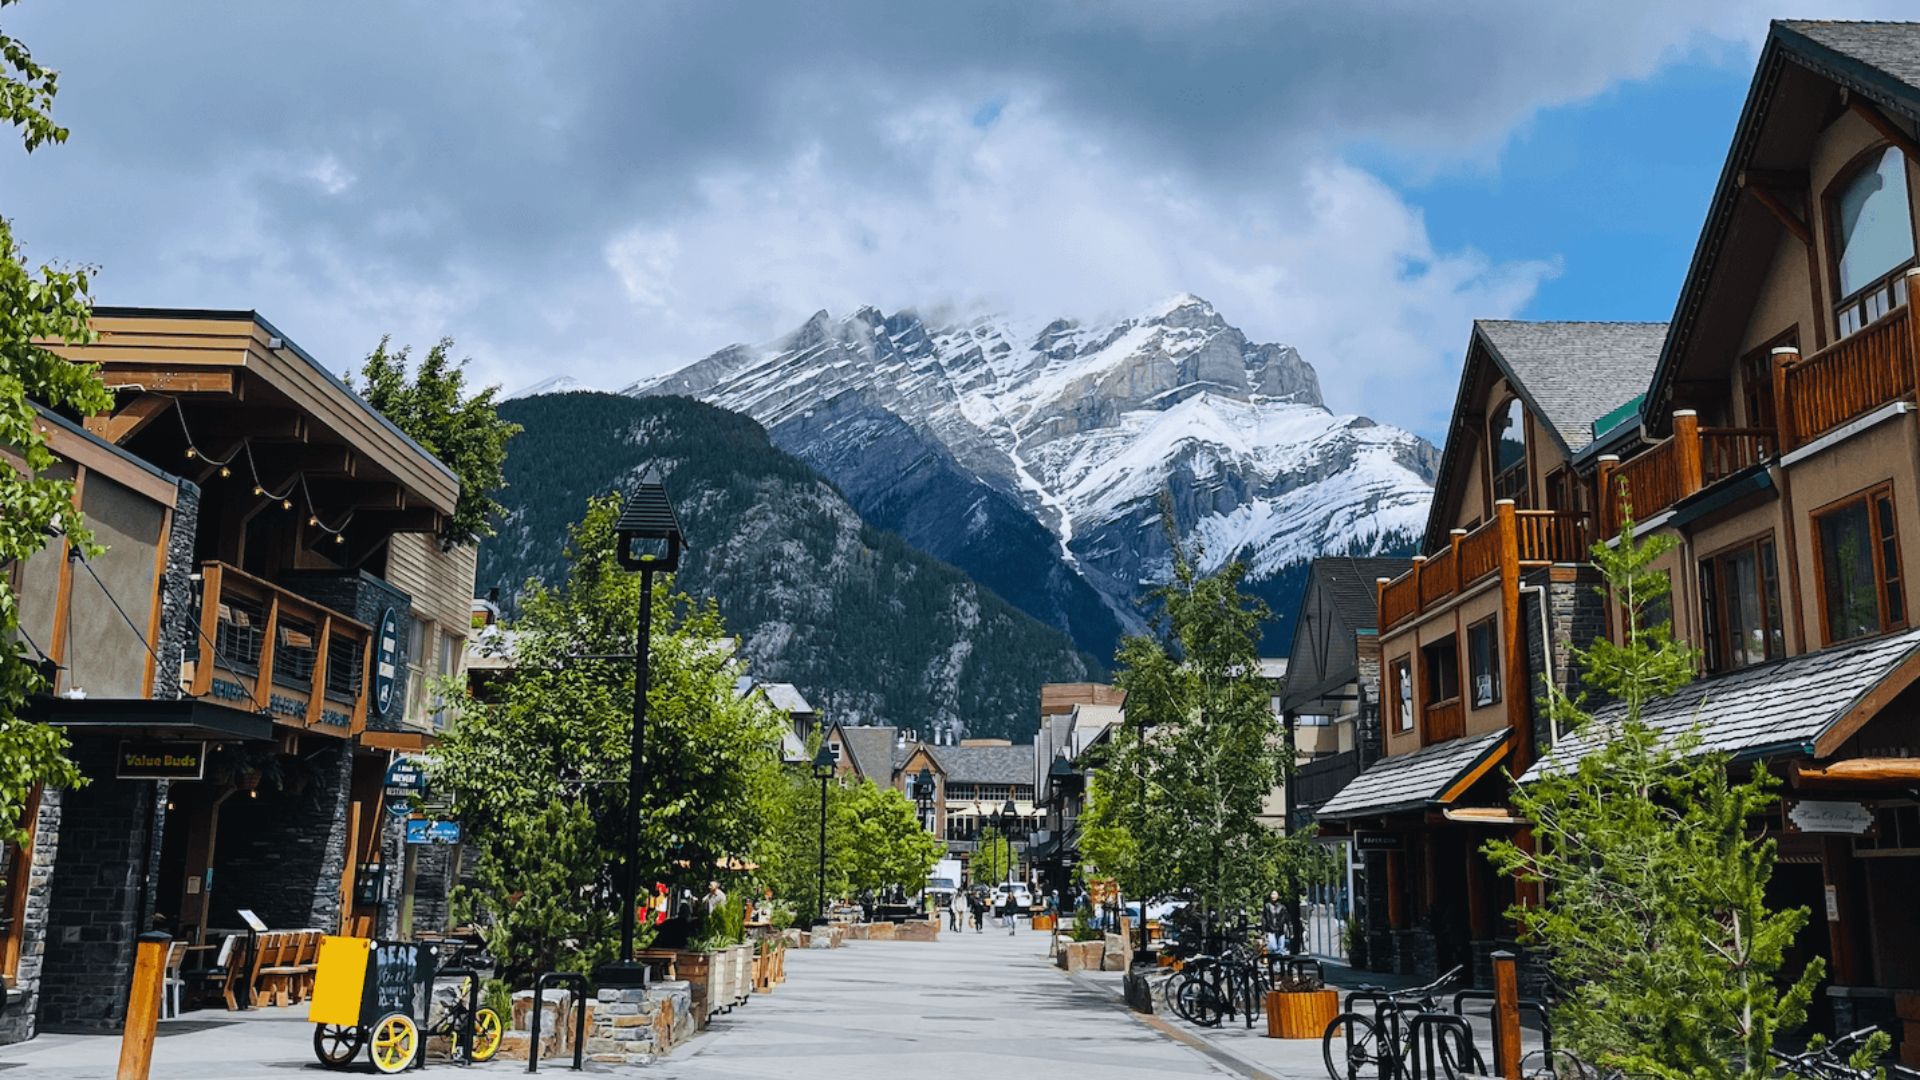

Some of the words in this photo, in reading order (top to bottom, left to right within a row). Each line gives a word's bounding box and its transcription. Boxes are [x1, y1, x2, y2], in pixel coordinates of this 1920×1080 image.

[126, 754, 161, 766] Value
[164, 754, 196, 766] Buds
[377, 945, 418, 967] BEAR
